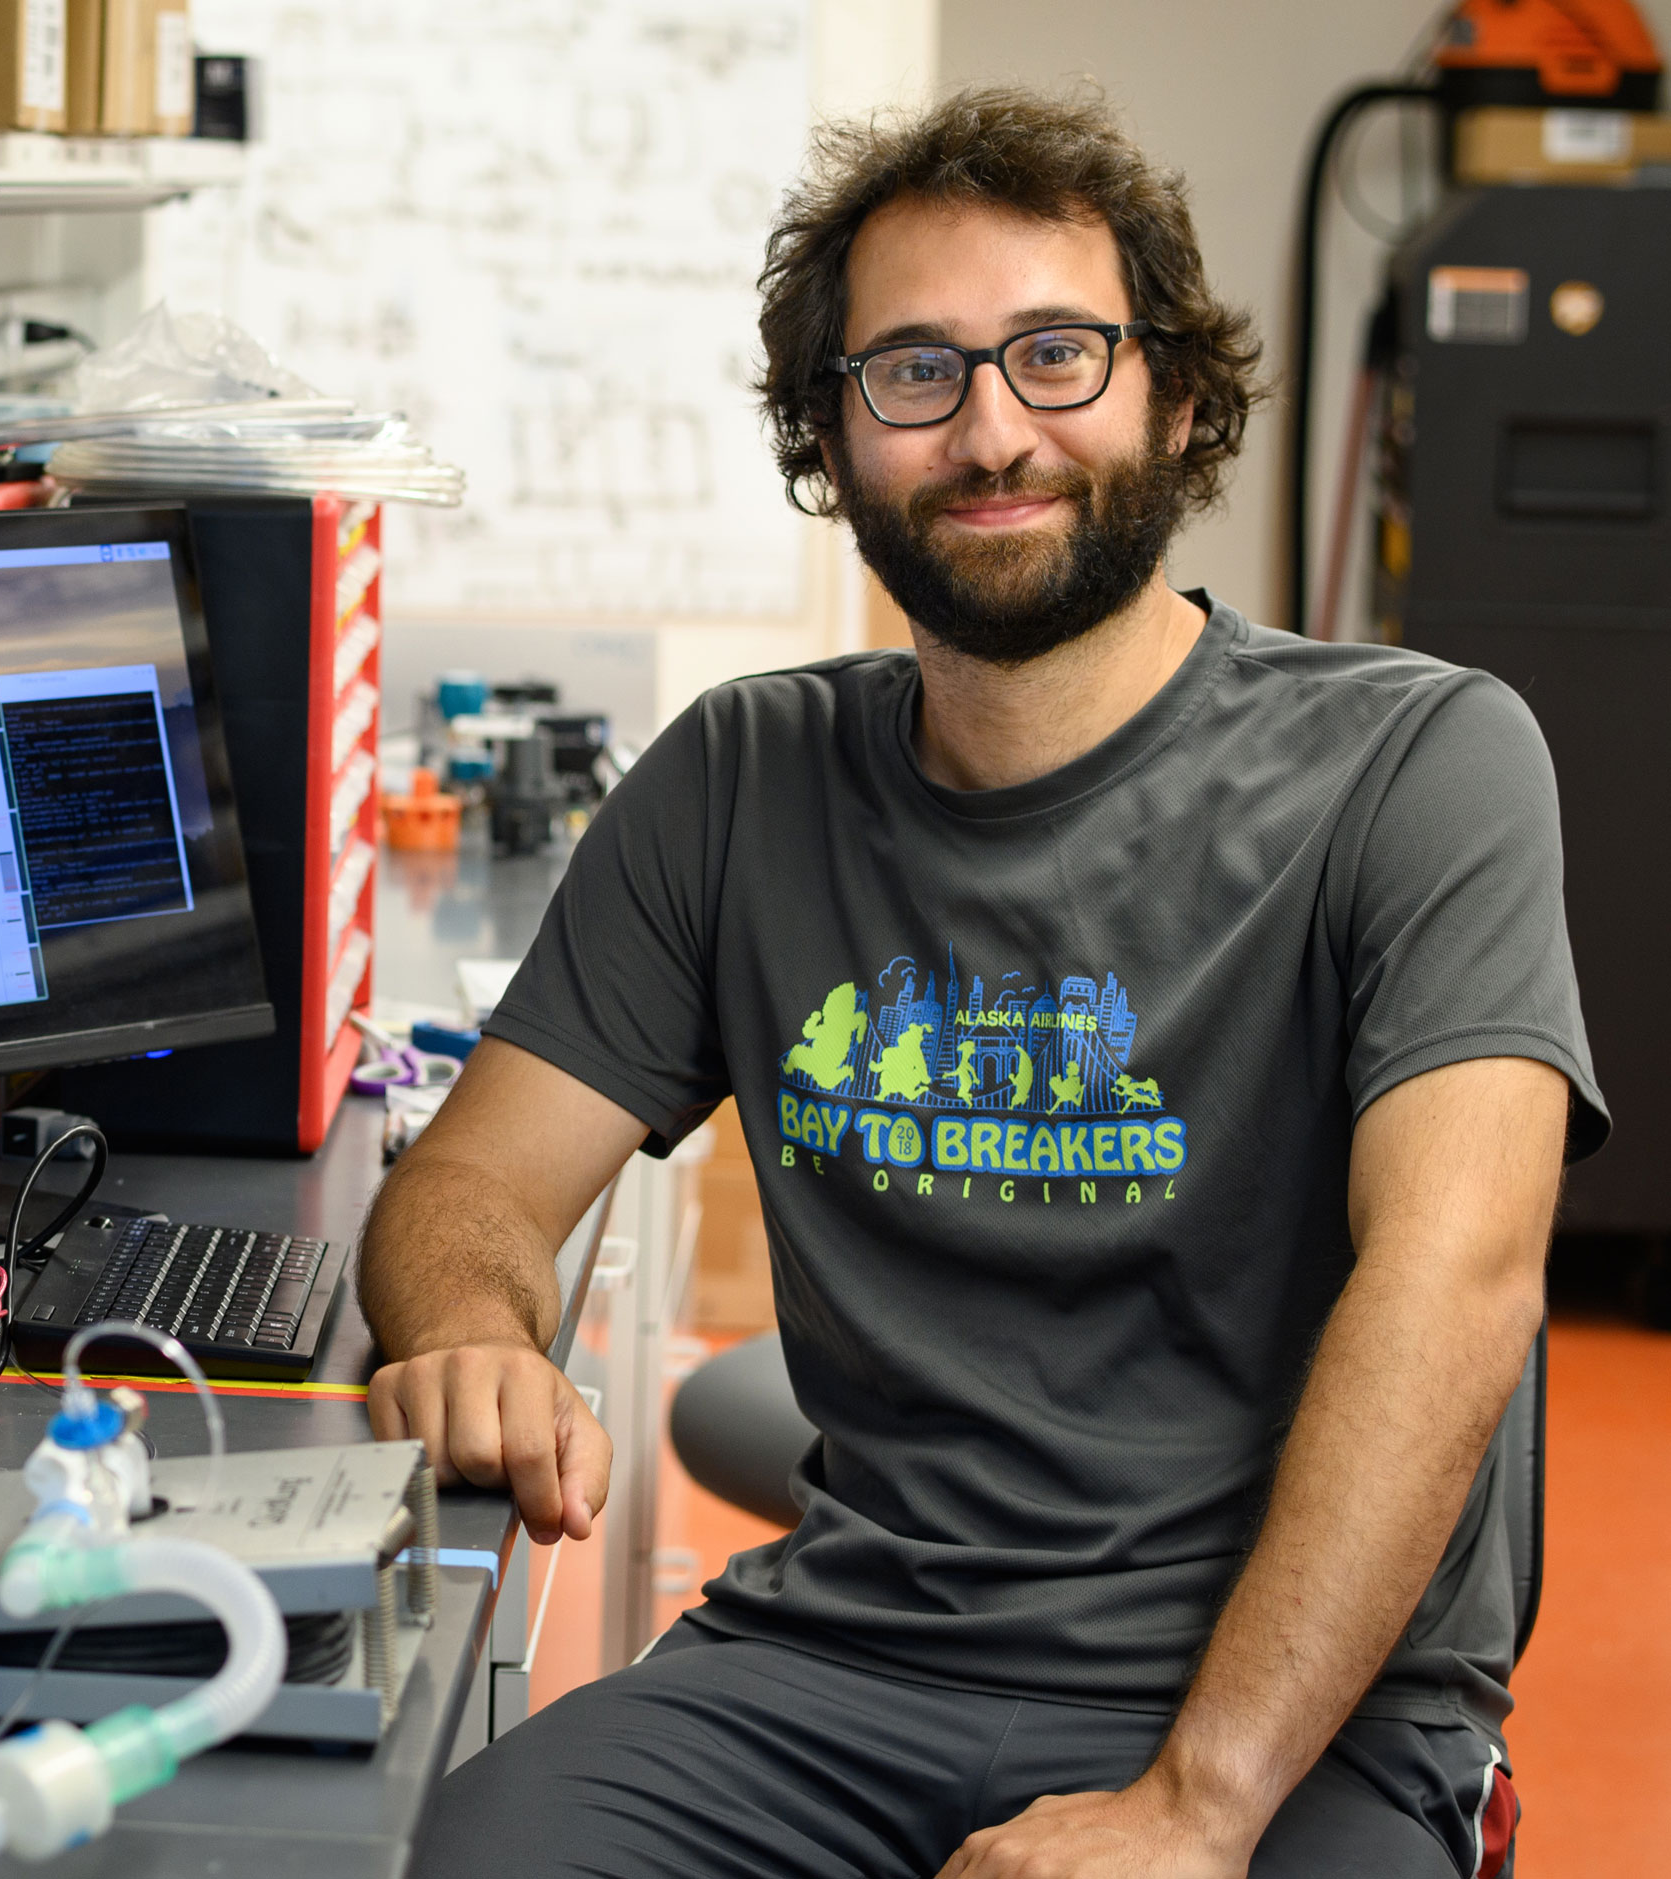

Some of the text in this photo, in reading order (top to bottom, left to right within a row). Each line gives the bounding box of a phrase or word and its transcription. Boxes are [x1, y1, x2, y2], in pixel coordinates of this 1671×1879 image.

[954, 1009, 1025, 1028] ALASKA
[1030, 1011, 1098, 1032] AIRLINES
[780, 1091, 1185, 1173] BAY TO BREAKERS
[897, 1125, 914, 1140] 20
[899, 1140, 912, 1155] 18
[780, 1145, 1176, 1203] BE ORIGINAL
